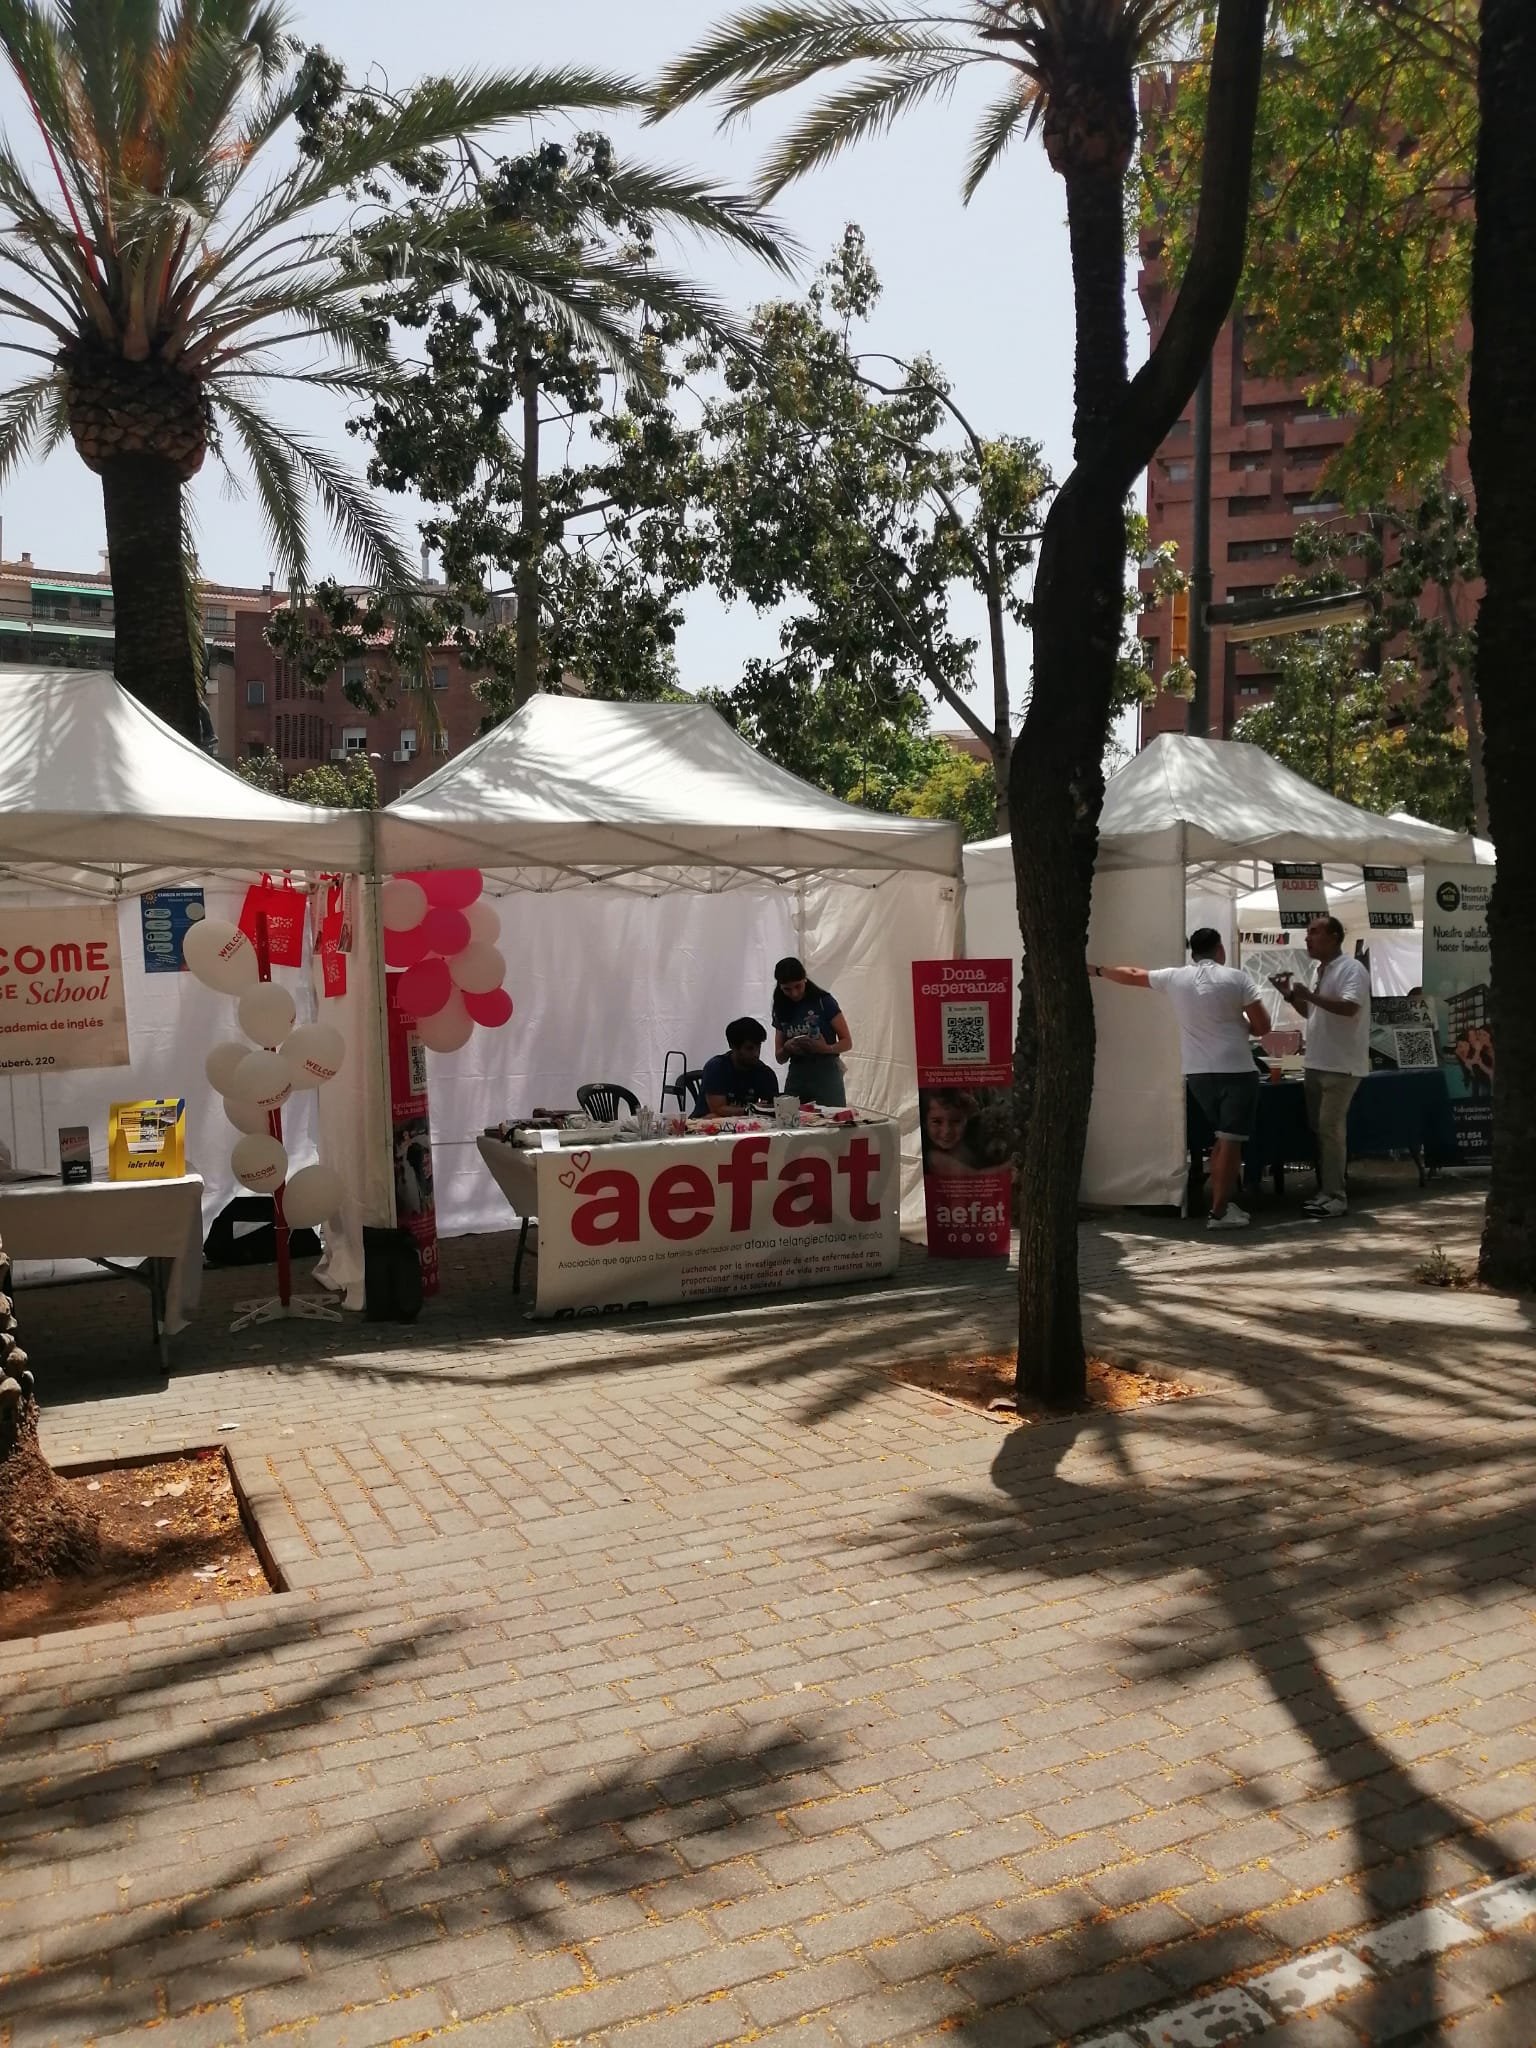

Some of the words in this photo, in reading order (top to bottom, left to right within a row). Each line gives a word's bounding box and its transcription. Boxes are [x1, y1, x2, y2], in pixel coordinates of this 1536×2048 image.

[1282, 880, 1320, 892] ALQUILER
[1376, 883, 1399, 893] VENTA
[942, 967, 987, 981] Dona
[26, 975, 110, 1006] School
[922, 981, 1006, 998] esperanza
[50, 1020, 64, 1030] de
[67, 1017, 104, 1031] inglés
[36, 1056, 55, 1066] 220
[570, 1136, 881, 1246] aefat
[936, 1201, 1005, 1223] aefat
[558, 1256, 600, 1270] Asociación
[602, 1256, 618, 1268] que
[619, 1254, 647, 1266] agrupa
[648, 1254, 654, 1262] a
[656, 1252, 666, 1261] las
[744, 1238, 776, 1250] ataxia
[720, 1263, 732, 1272] por
[735, 1262, 742, 1270] la
[793, 1256, 802, 1264] de
[822, 1250, 864, 1262] enfermedad
[682, 1274, 730, 1286] proporcionar
[786, 1266, 795, 1276] de
